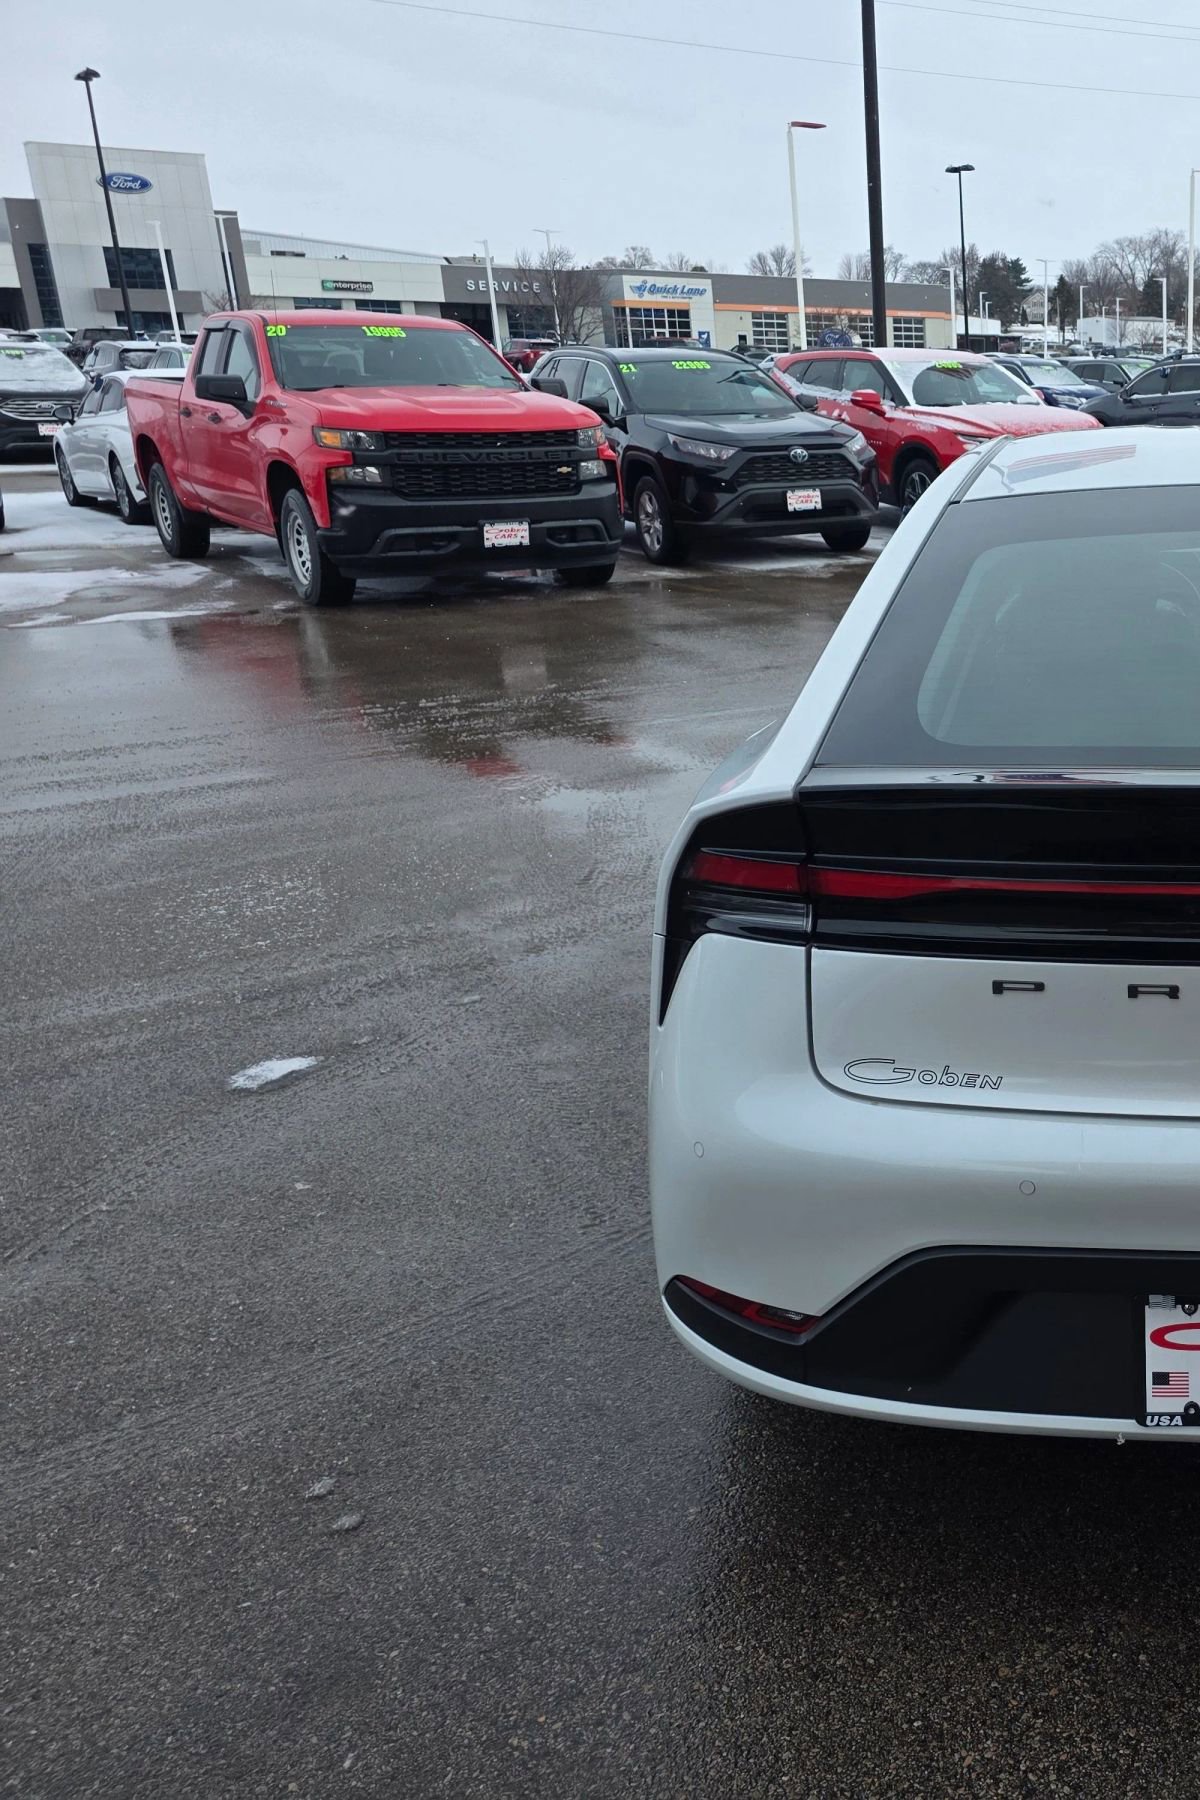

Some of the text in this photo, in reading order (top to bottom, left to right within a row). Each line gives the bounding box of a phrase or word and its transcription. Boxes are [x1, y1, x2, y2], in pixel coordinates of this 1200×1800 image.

[110, 176, 142, 190] Ford
[466, 280, 541, 293] SERVICE
[647, 284, 707, 297] Quick Lane
[266, 325, 286, 337] 20
[619, 363, 637, 373] 21
[1146, 1415, 1183, 1426] USA
